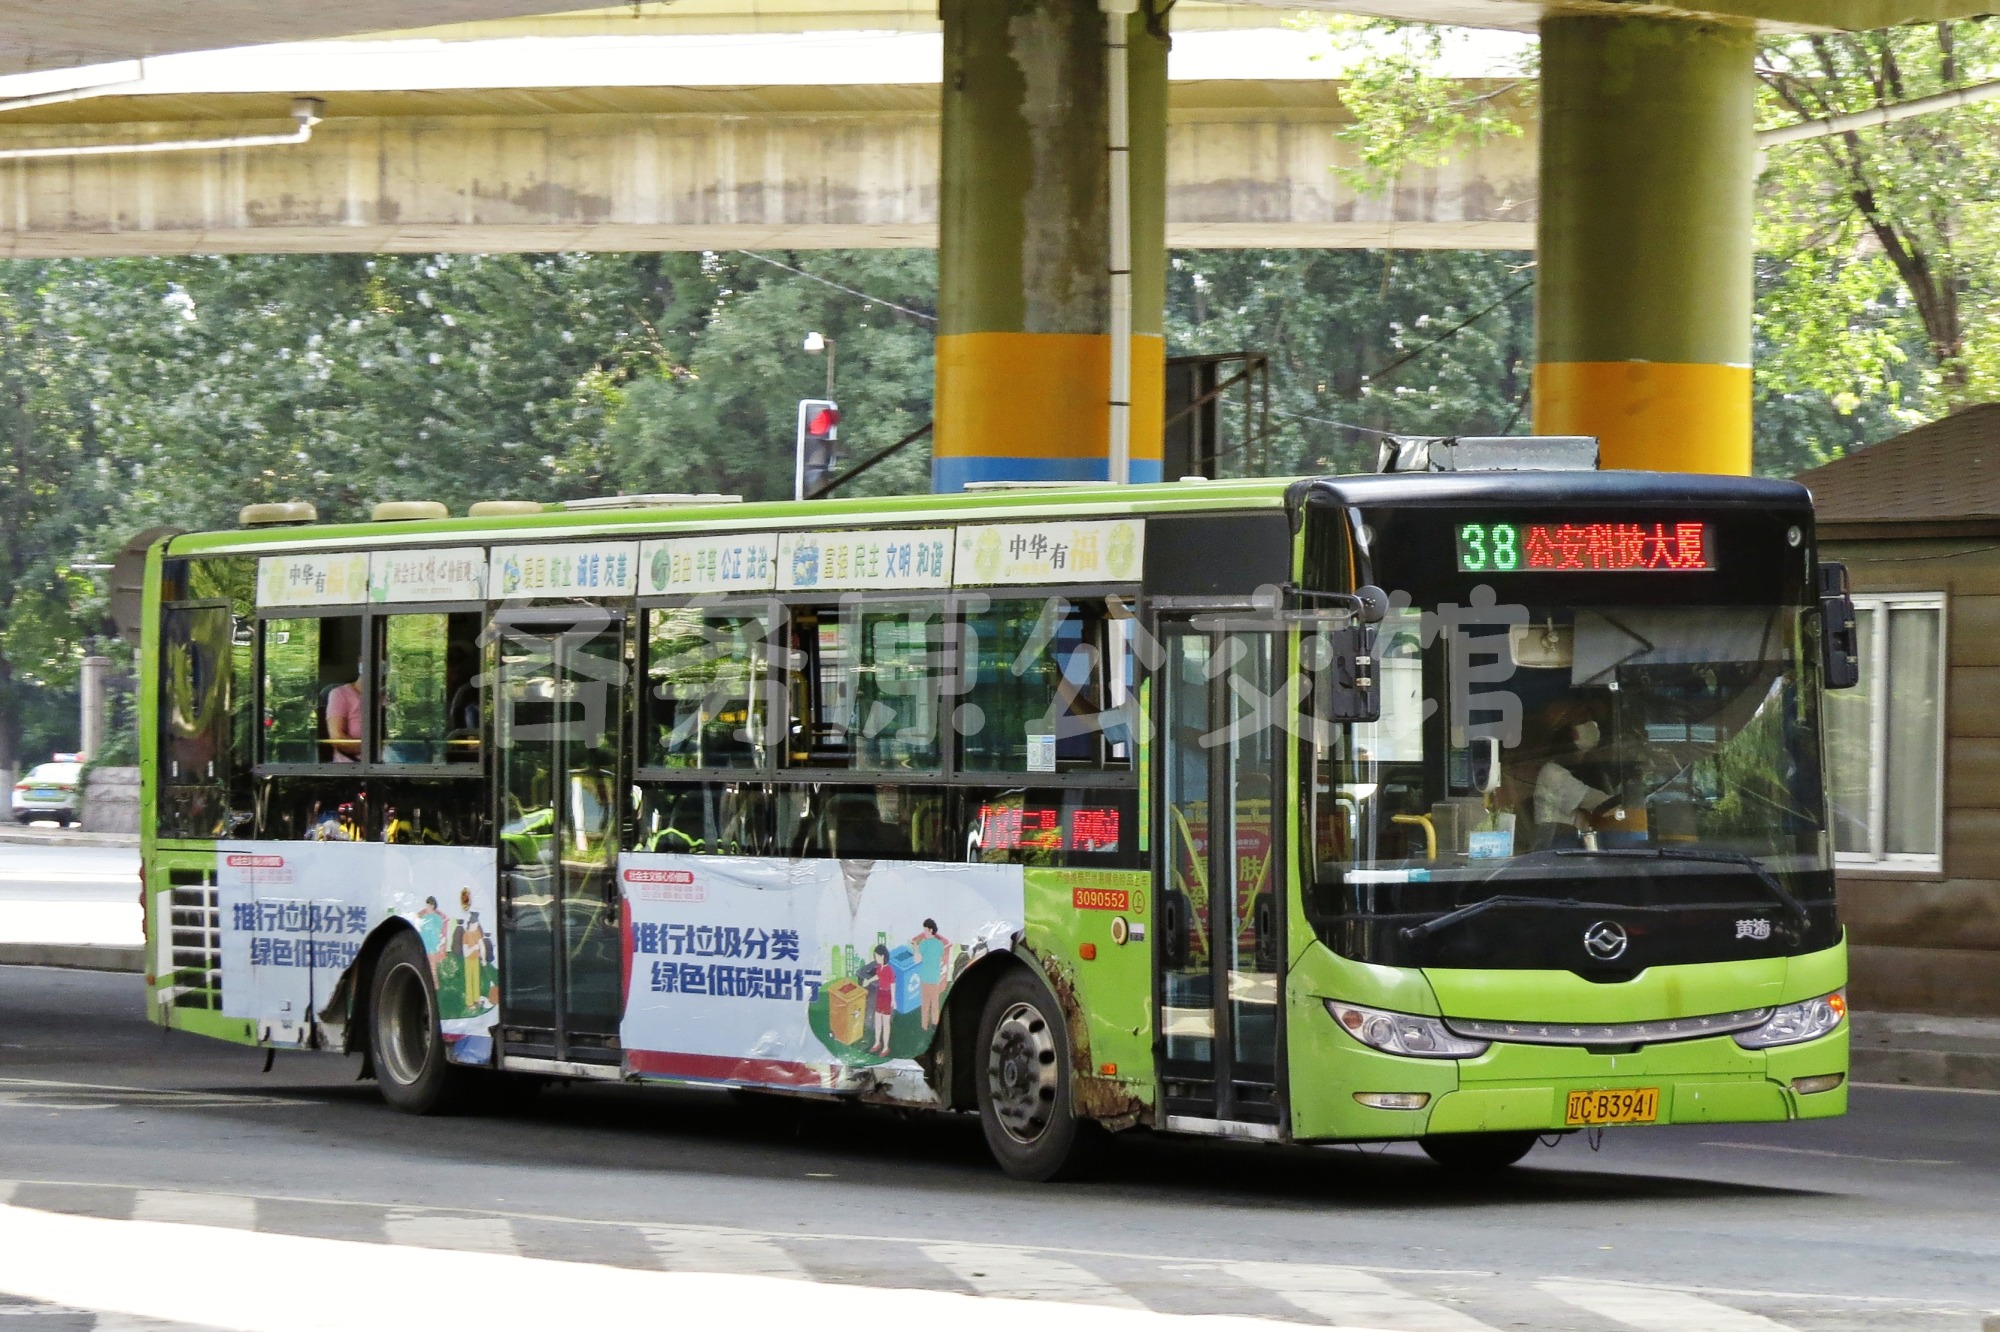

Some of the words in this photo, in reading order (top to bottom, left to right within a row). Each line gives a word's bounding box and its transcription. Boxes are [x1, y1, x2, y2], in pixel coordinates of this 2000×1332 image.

[721, 547, 742, 579] 公正
[746, 545, 767, 580] 法治
[855, 542, 879, 578] 民主
[885, 542, 911, 578] 文明
[917, 541, 943, 578] 和谐
[1009, 528, 1100, 573] 中华有福
[1462, 524, 1516, 569] 38
[1526, 523, 1706, 570] 公安科技大厦
[577, 553, 600, 587] 诚信
[604, 552, 626, 587] 友善
[1076, 890, 1126, 908] 3090552
[233, 901, 367, 934] 推行垃圾分类
[1736, 918, 1771, 940] 黄海
[632, 921, 800, 962] 推行垃圾分类
[651, 960, 823, 1003] 绿色低碳出行
